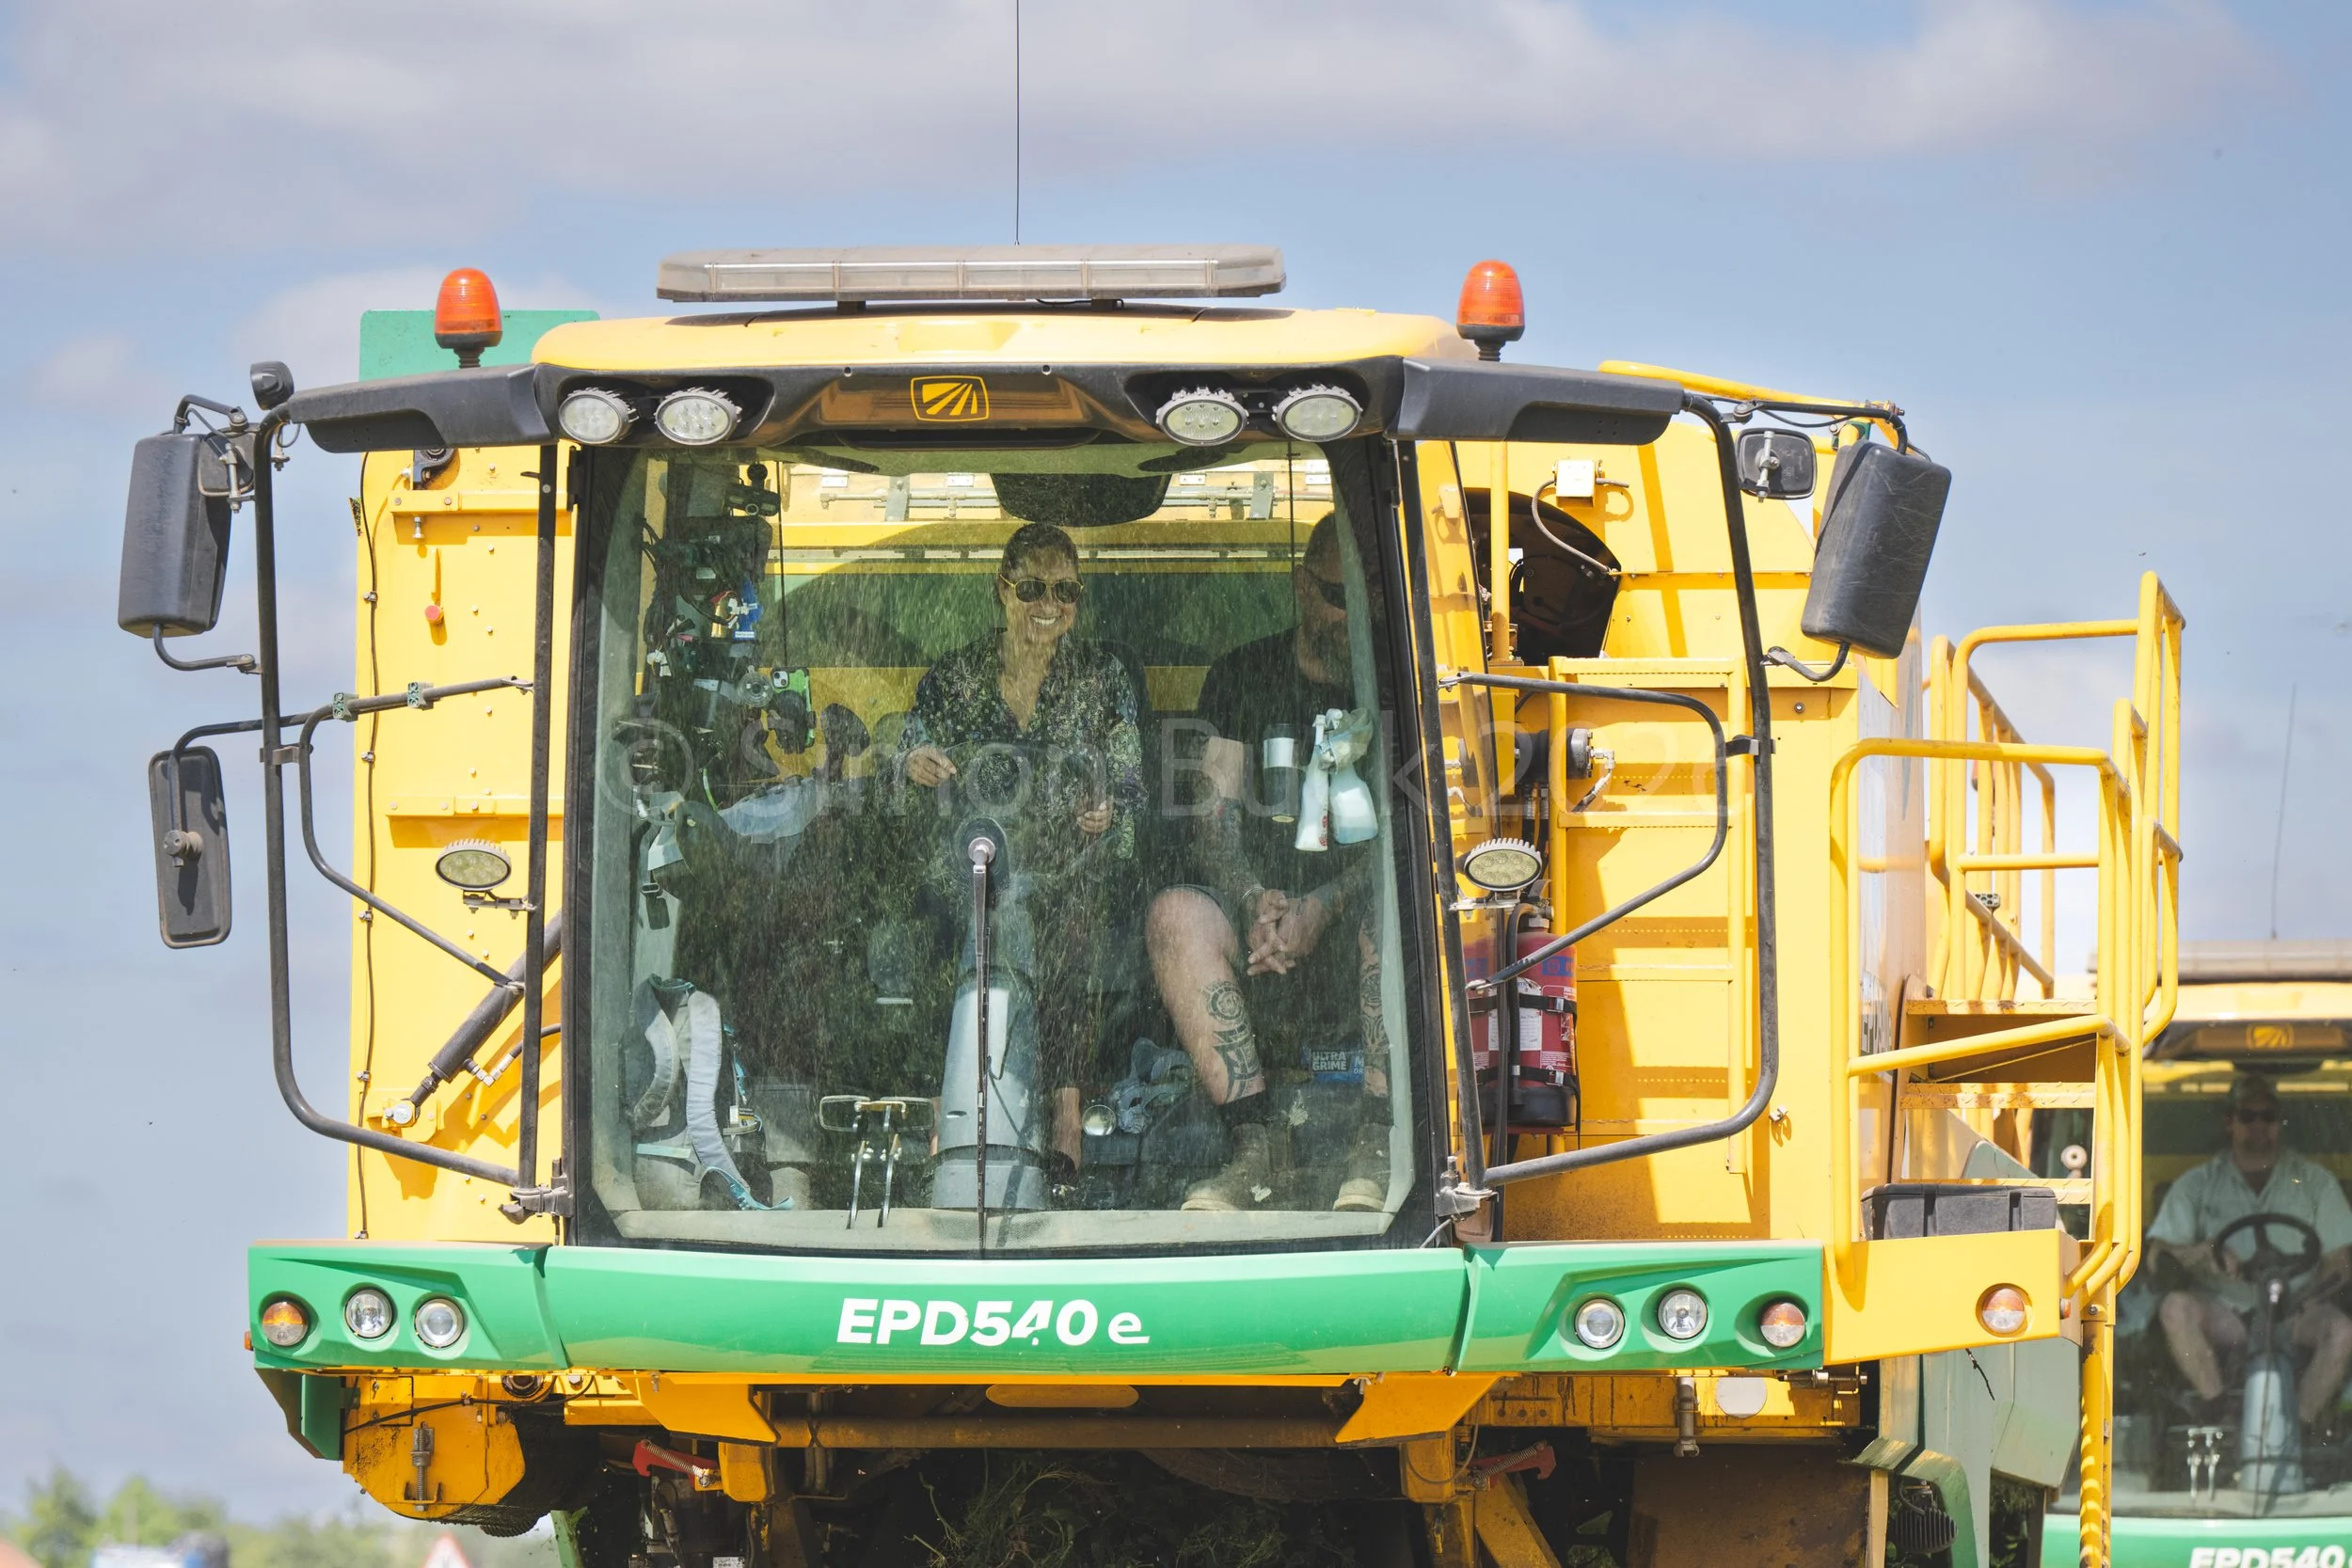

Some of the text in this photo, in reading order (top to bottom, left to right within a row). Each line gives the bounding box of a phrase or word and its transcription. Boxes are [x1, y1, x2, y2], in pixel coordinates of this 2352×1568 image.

[1311, 1051, 1346, 1061] ULTRA
[1311, 1060, 1347, 1070] GRIME
[836, 1298, 1151, 1347] EPD540 e
[2189, 1544, 2346, 1568] EPD540
